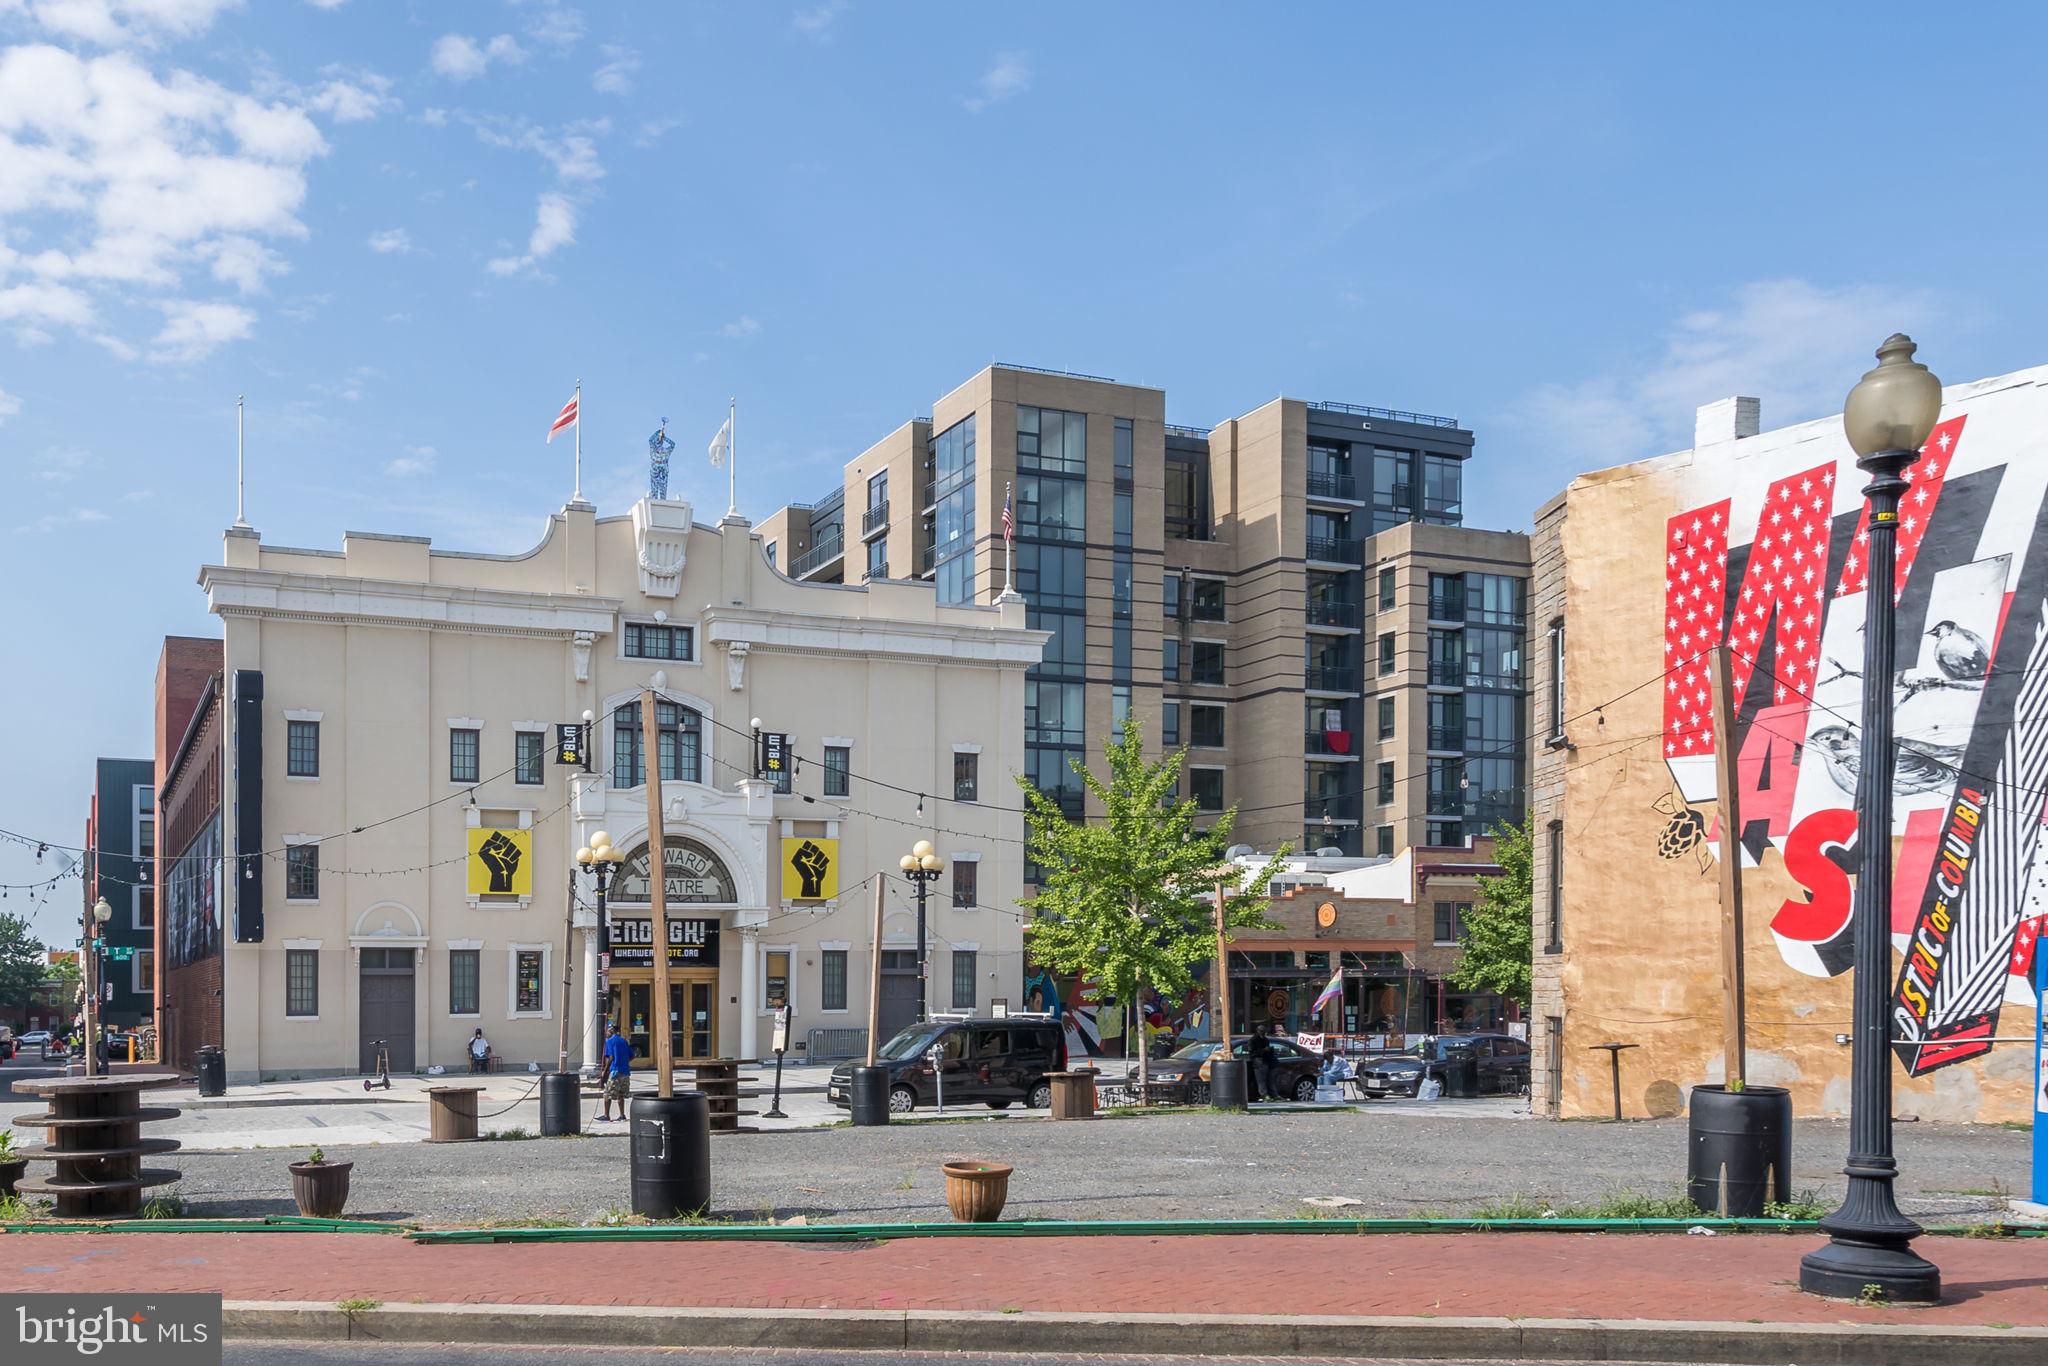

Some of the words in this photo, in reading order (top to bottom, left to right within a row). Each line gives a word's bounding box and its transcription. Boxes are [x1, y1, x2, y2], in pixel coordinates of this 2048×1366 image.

[563, 726, 576, 762] #BLM
[768, 735, 780, 769] #BLM
[1936, 788, 1982, 898] COLUMBIA
[639, 848, 707, 873] HWARD
[609, 921, 705, 943] ENOGH!
[1931, 901, 1951, 932] OF
[113, 946, 120, 955] T
[1894, 913, 1946, 1042] DISTRICT
[1299, 1036, 1322, 1046] OPEN
